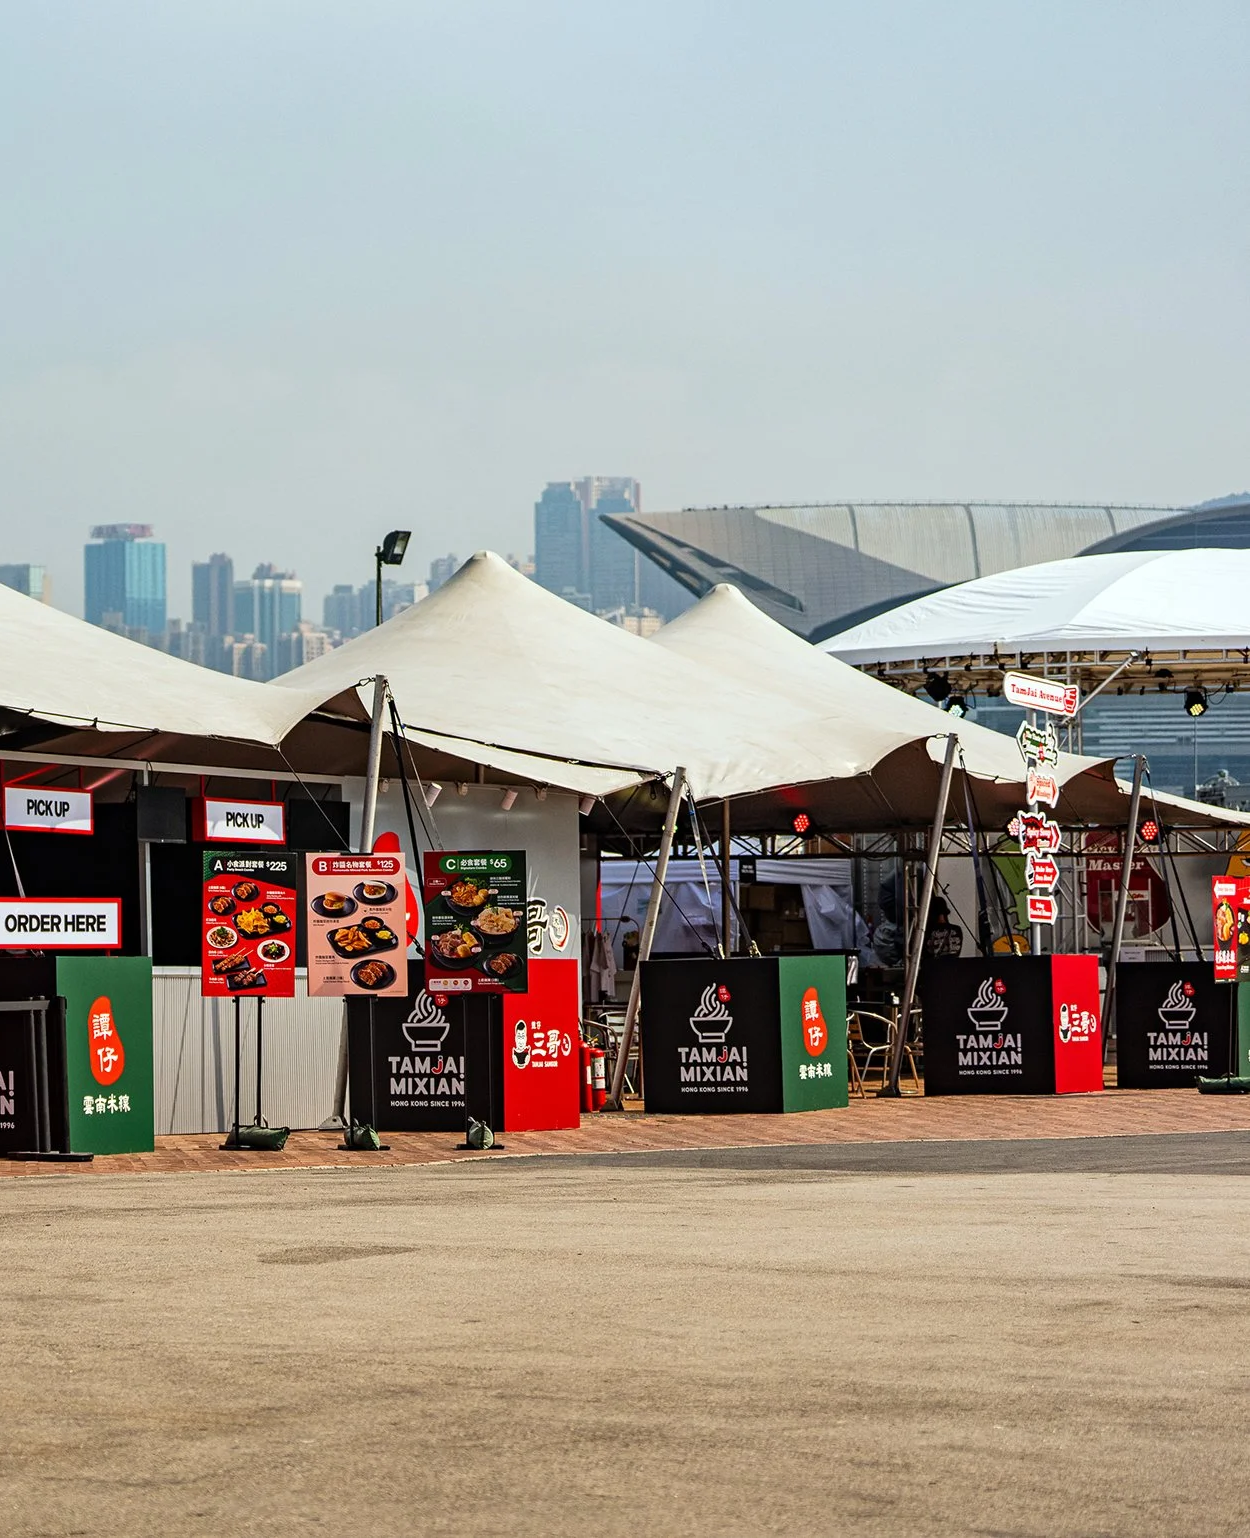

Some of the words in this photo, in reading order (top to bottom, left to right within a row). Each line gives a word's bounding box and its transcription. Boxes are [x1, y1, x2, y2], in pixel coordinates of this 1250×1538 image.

[1039, 690, 1062, 703] Avenue
[26, 798, 53, 817] PICK
[55, 800, 70, 818] UP
[226, 811, 249, 828] PICK
[250, 812, 264, 829] UP
[214, 860, 223, 870] A
[266, 861, 287, 871] $225
[319, 861, 327, 871] B
[377, 860, 394, 868] $125
[446, 859, 456, 870] C
[490, 859, 507, 868] $65
[1088, 860, 1144, 870] Maser
[5, 914, 61, 933] ORDER
[64, 914, 107, 932] HERE
[804, 1000, 823, 1046] 譚仔
[93, 1013, 118, 1073] 譚仔
[958, 1051, 1022, 1066] MIXIAN
[1149, 1047, 1208, 1060] MIXIAN
[680, 1065, 748, 1082] MIXIAN
[390, 1077, 465, 1095] MIXIAN
[83, 1093, 131, 1115] 雲南米線
